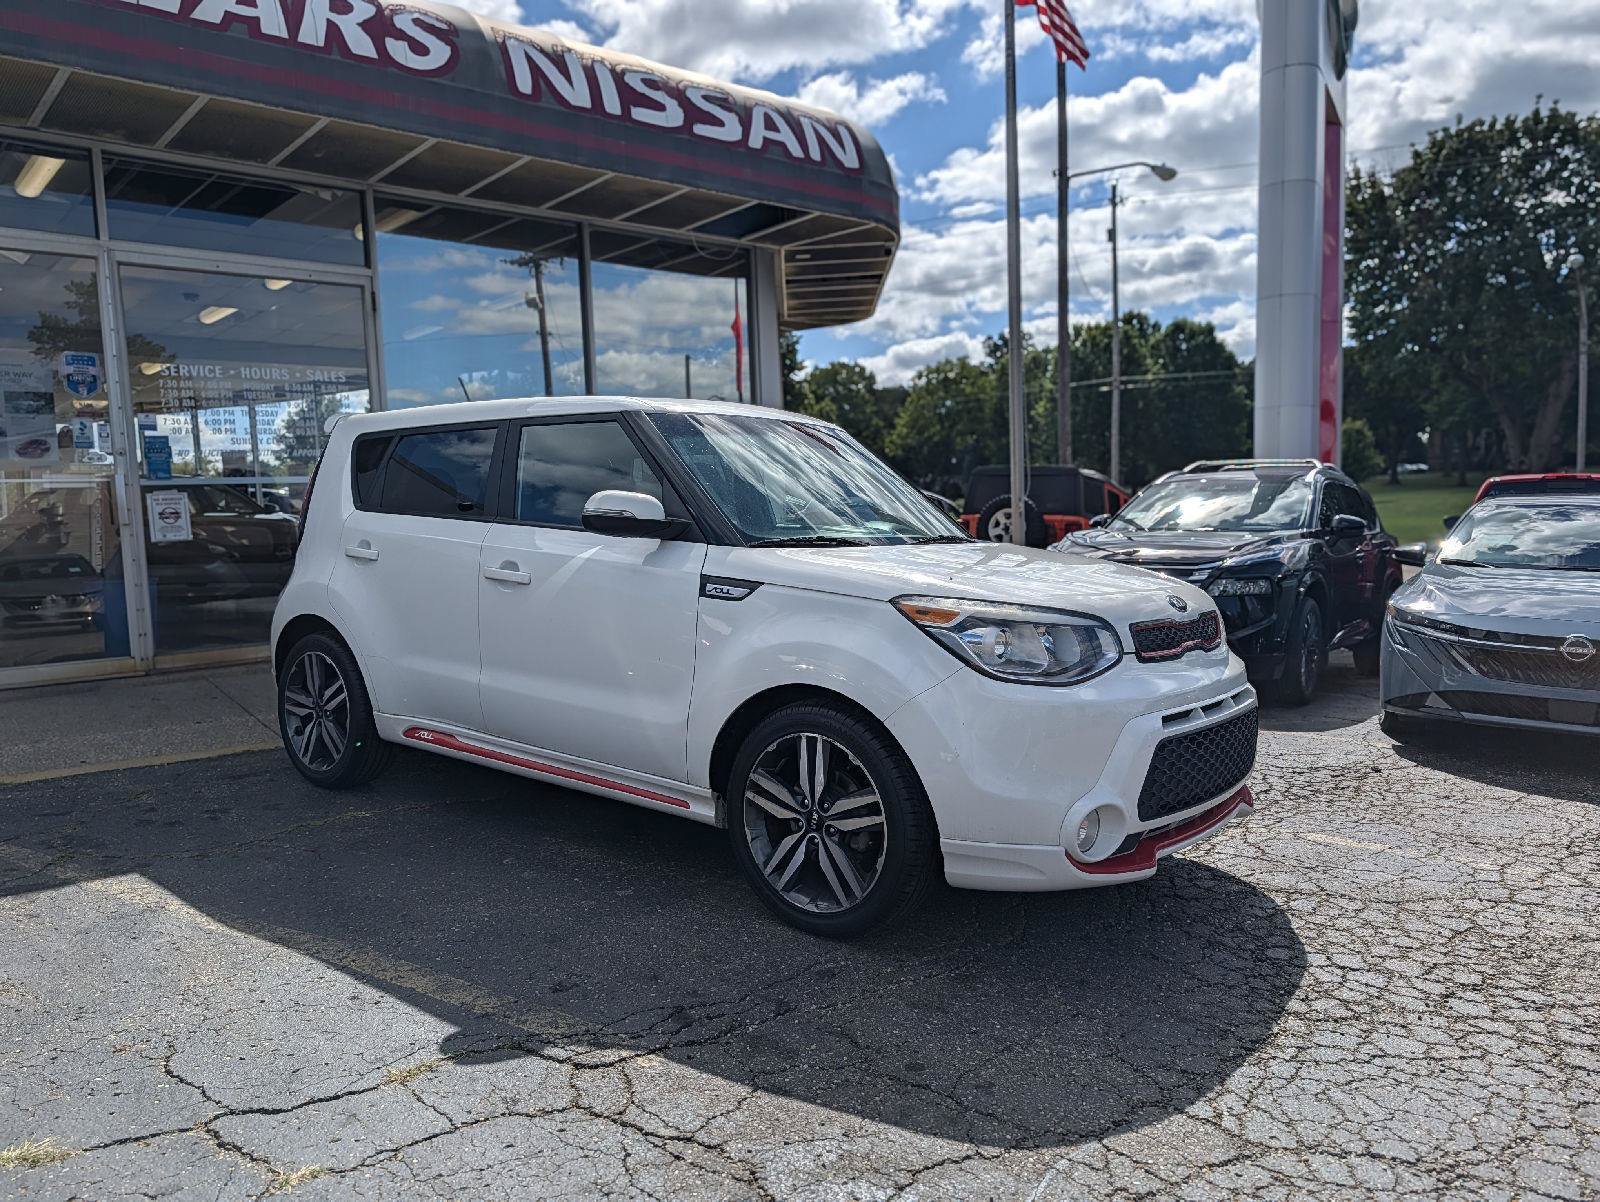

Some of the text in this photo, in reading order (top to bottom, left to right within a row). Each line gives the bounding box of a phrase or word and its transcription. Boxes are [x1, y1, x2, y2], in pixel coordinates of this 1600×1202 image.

[121, 0, 861, 169] ARS NISSAN
[160, 363, 346, 382] SERVICE HOURS SALES
[243, 391, 275, 399] TUESDAY
[240, 409, 278, 417] THRSDAY
[163, 418, 181, 426] 7:30
[204, 418, 221, 426] 6:00
[223, 418, 236, 426] PM
[225, 428, 237, 436] PM
